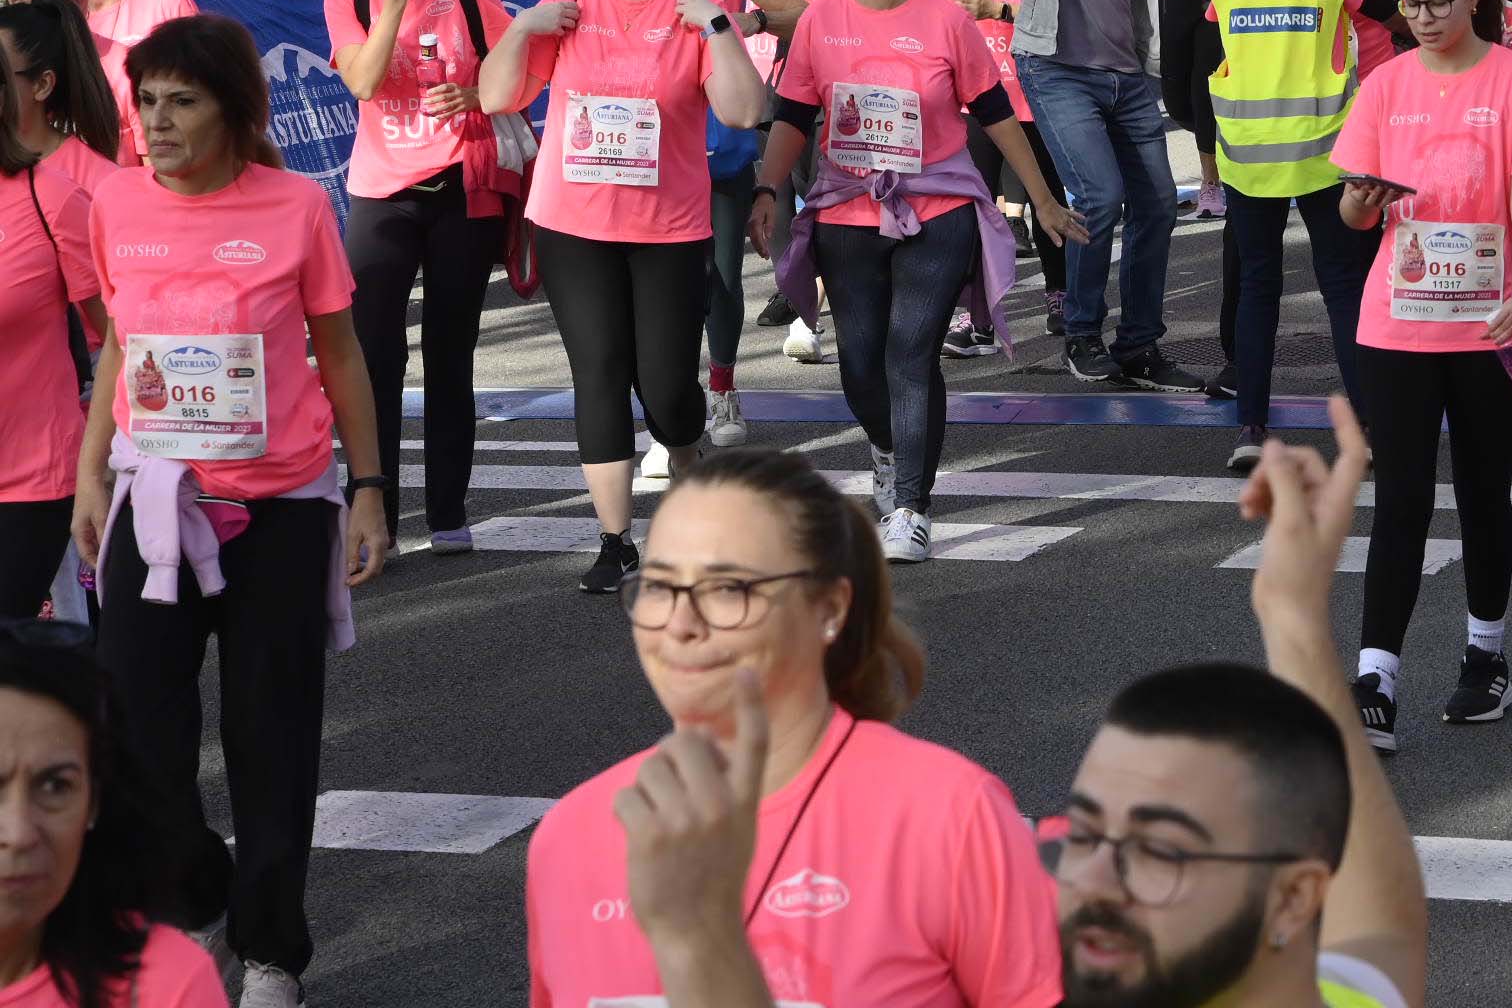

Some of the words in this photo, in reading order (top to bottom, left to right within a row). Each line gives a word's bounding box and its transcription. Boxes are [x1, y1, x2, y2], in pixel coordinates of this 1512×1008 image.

[1231, 13, 1314, 28] VOLUNTARIS
[579, 24, 616, 38] OYSHO
[824, 35, 862, 47] OYSHO
[379, 98, 401, 112] TU
[864, 99, 897, 110] ASTURIANA
[596, 111, 630, 121] ASTURIANA
[1390, 113, 1431, 126] OYSHO
[863, 118, 894, 132] 016
[595, 131, 627, 144] 016
[865, 133, 889, 143] 26172
[598, 147, 623, 156] 26169
[837, 153, 866, 161] OYSHO
[571, 169, 601, 177] OYSHO
[622, 171, 652, 179] Santander
[1428, 239, 1469, 249] ASTURIANA
[116, 244, 169, 258] OYSHO
[1429, 262, 1466, 276] 016
[1432, 280, 1461, 289] 11317
[1400, 304, 1434, 314] OYSHO
[1460, 305, 1493, 313] Santander
[166, 357, 217, 368] ASTURIANA
[171, 385, 216, 403] 016
[181, 407, 209, 418] 8815
[144, 422, 181, 430] CARRERA
[182, 423, 193, 431] DE
[194, 423, 205, 431] LA
[205, 424, 231, 432] MUJER
[140, 438, 179, 449] OYSHO
[211, 439, 256, 450] Santander
